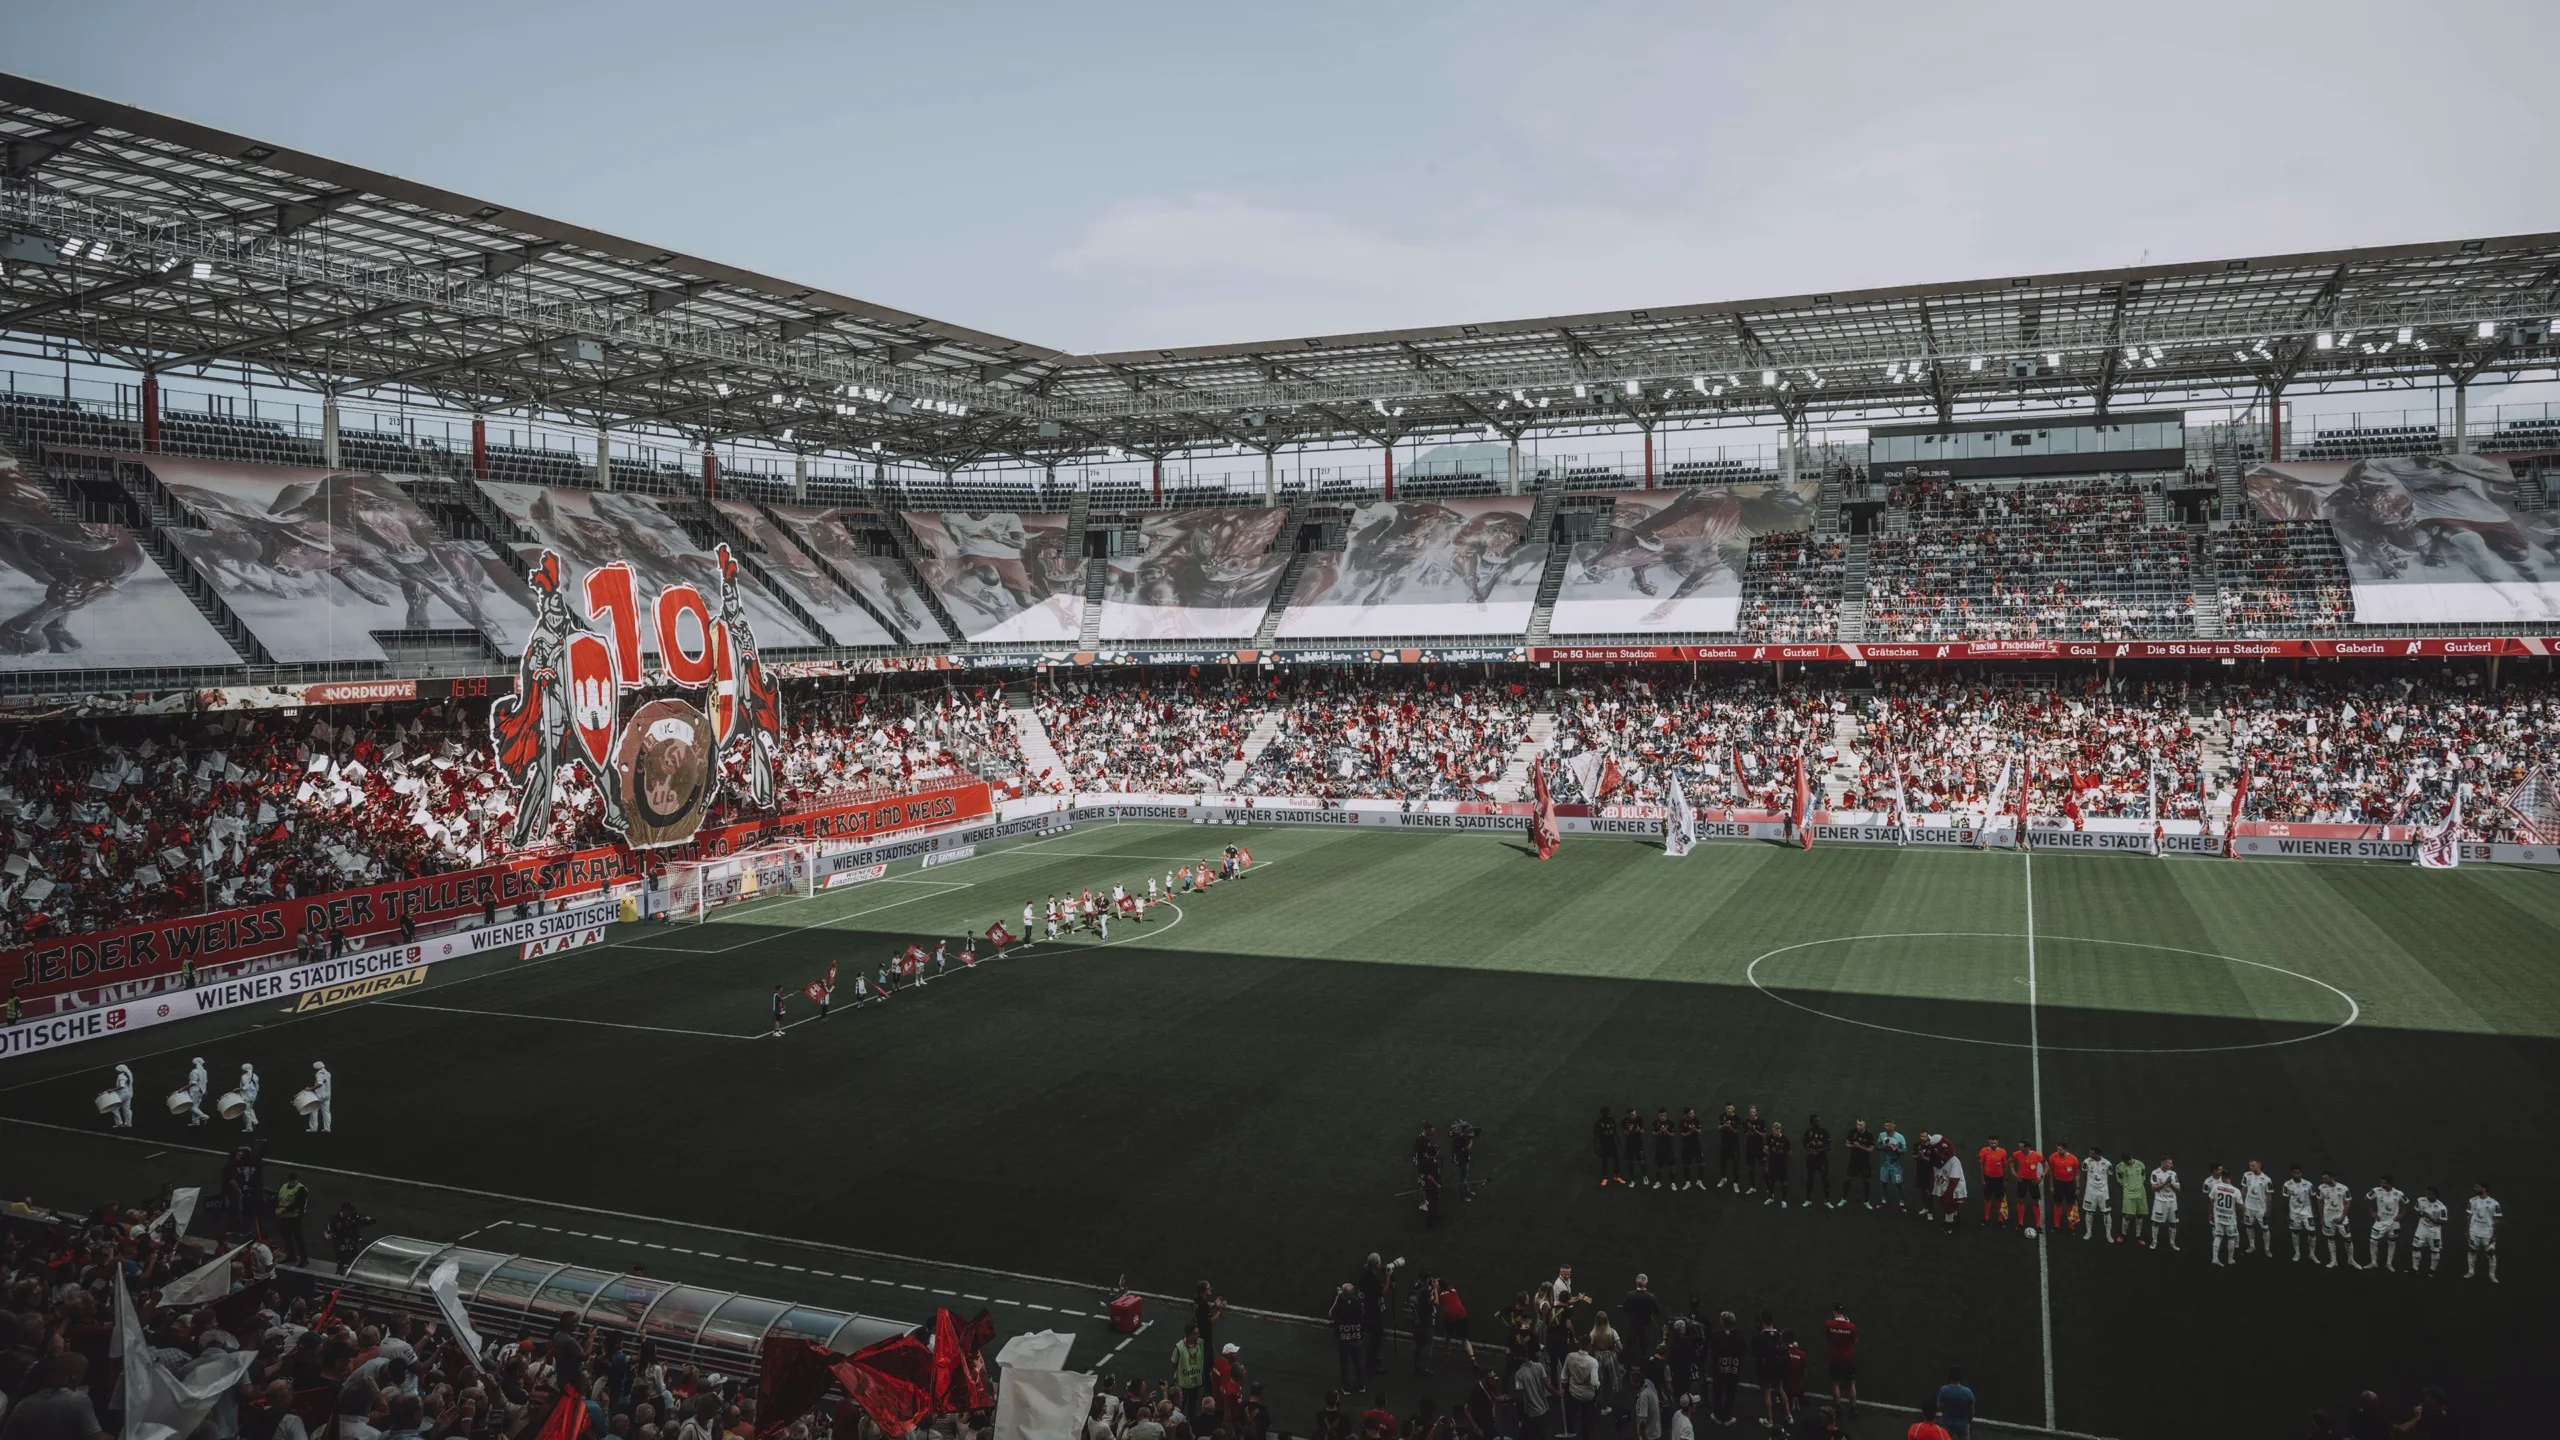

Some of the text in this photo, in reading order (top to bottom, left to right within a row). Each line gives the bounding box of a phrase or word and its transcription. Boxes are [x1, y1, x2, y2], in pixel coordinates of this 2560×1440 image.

[388, 418, 401, 426] 213
[583, 561, 714, 690] 10
[1753, 646, 1765, 659] A1
[1783, 648, 1819, 657] Gurkerl
[1867, 647, 1919, 656] Grätschen
[1936, 645, 1949, 658] A1
[1970, 641, 1998, 651] Fanclub
[2070, 645, 2096, 655] Goal
[2115, 643, 2129, 656] A1
[2147, 644, 2281, 655] Die 5G hier im Stadion:
[2406, 641, 2421, 655] A1
[2444, 642, 2491, 652] Gurkerl
[1553, 649, 1657, 659] Die 5G hier im Stadion:
[329, 683, 413, 701] NORDKURVE
[1068, 806, 1177, 822] WIENER STÄDTISCHE
[1225, 809, 1347, 824] WIENER STÄDTISCHE
[1400, 814, 1451, 827] WIENER
[1646, 806, 1698, 821] SALZG
[963, 817, 1042, 845] WIENER STÄDTISCHE
[1590, 820, 1735, 836] WIENER STISCHE
[1813, 826, 1957, 842] IENER STÄDISCHE
[2027, 832, 2201, 851] WIENER STÄDTCHE
[2278, 839, 2352, 856] WIENER
[2358, 841, 2471, 859] STÄDTE
[833, 839, 931, 872] WIENER STÄDTISCHE
[845, 867, 872, 878] WIENER
[12, 931, 160, 988] JEDER
[162, 909, 286, 960] WEISS
[305, 894, 375, 935] DER
[380, 875, 498, 921] TELLER
[502, 846, 647, 900] ERSTRAHLT
[654, 839, 701, 871] SEIT
[708, 839, 728, 857] 10
[813, 815, 830, 836] IN
[835, 811, 870, 834] ROT
[874, 805, 902, 829] UND
[906, 796, 957, 822] WEISS!
[471, 901, 620, 950] WIENER STÄDTISCHE
[529, 927, 602, 958] A1 A1 A1
[195, 975, 283, 1011] WIENER
[289, 949, 404, 991] STÄDTISCHE
[301, 969, 422, 1011] ADMIRAL
[2217, 1193, 2233, 1209] 20
[1340, 1324, 1361, 1332] FOTO
